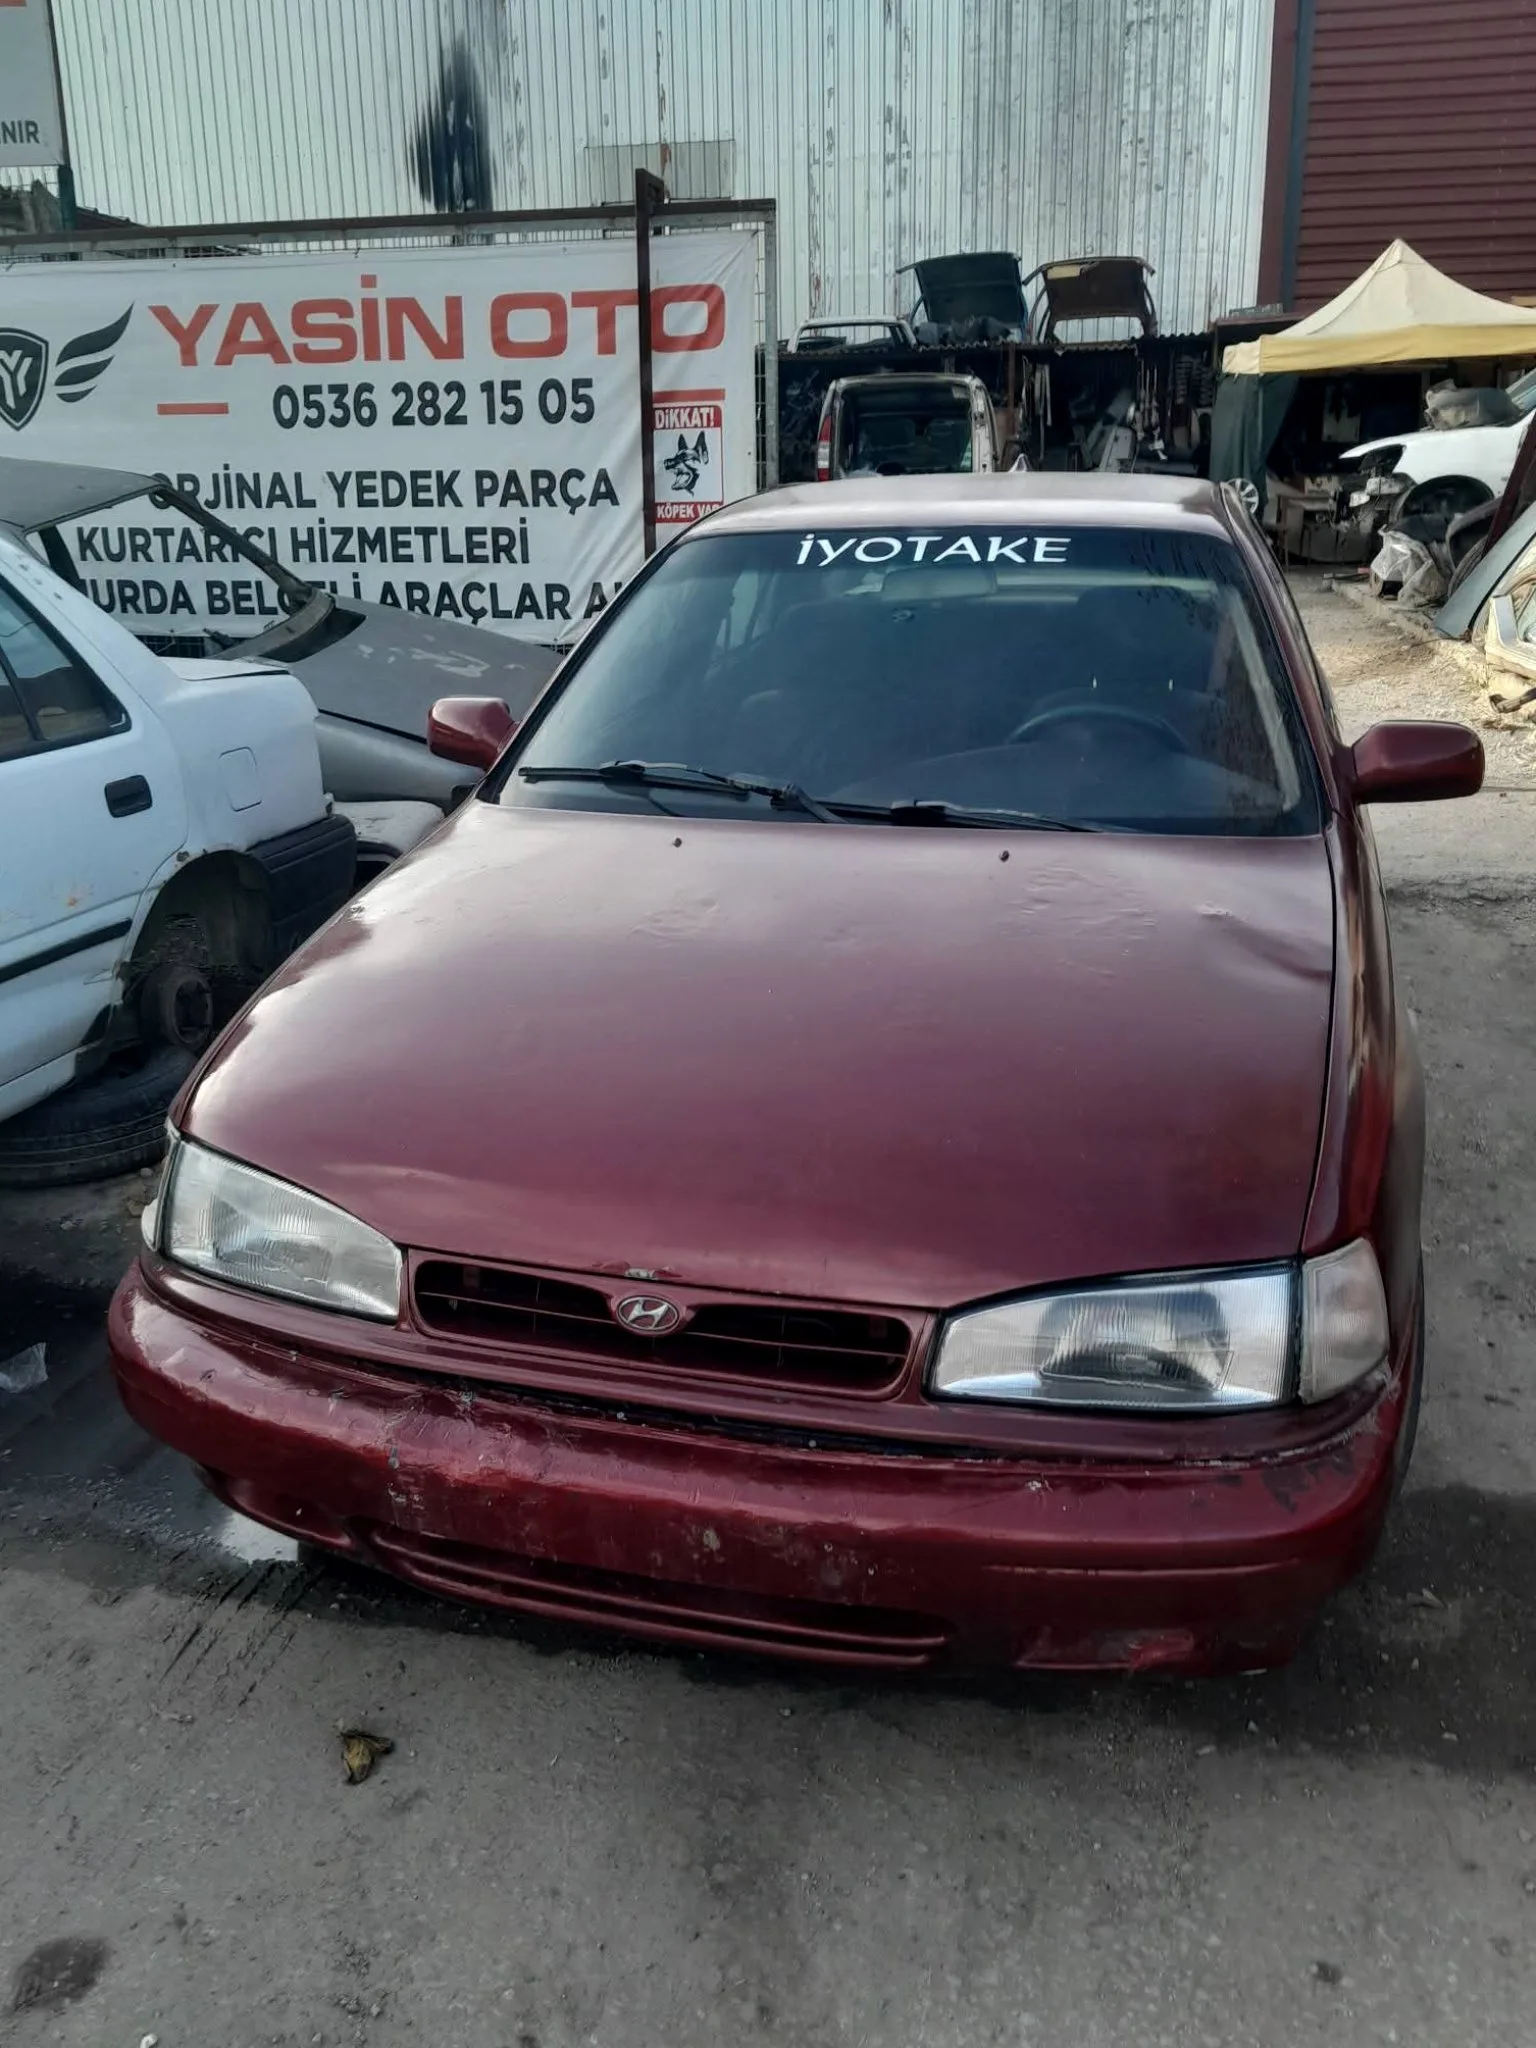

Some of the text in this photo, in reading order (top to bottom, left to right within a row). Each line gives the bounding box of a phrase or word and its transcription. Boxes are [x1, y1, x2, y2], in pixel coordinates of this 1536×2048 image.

[0, 119, 41, 145] NIR
[148, 274, 726, 367] YASİN OTO
[273, 377, 595, 429] 0536 282 15 05
[327, 469, 463, 508] YEDEK
[475, 467, 620, 515] PARÇA
[656, 502, 694, 519] KÖPEK
[290, 516, 530, 564] HİZMETLERİ
[379, 580, 572, 626] ARAÇLAR
[583, 581, 623, 620] A
